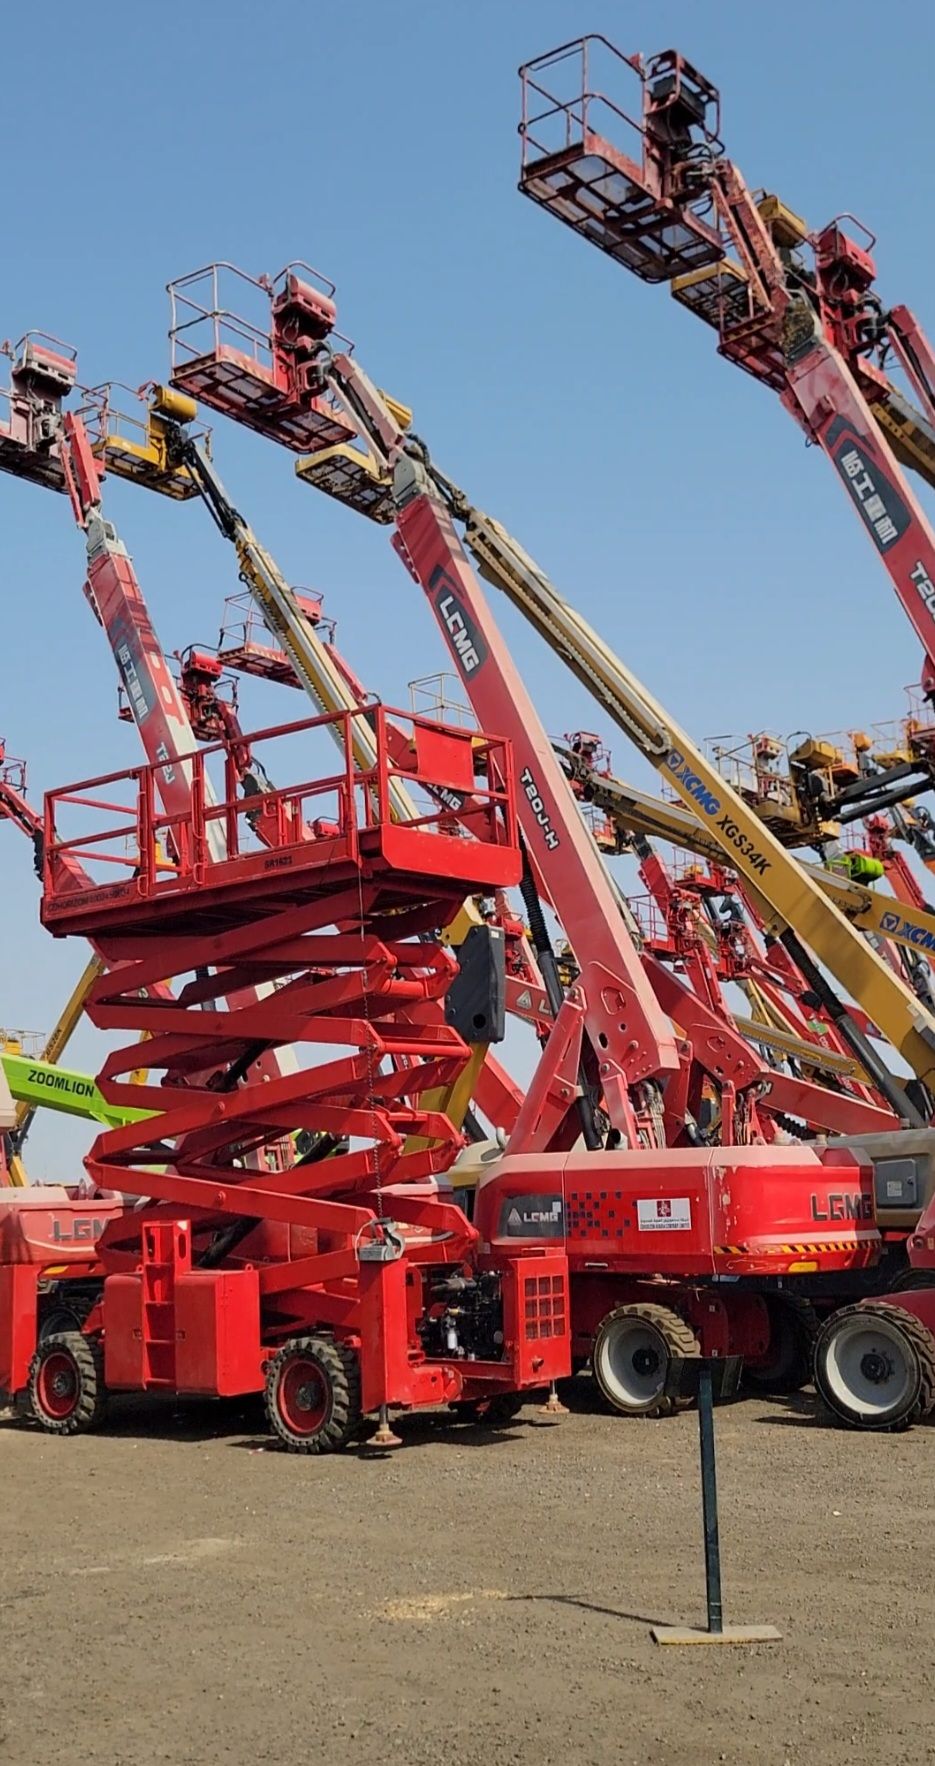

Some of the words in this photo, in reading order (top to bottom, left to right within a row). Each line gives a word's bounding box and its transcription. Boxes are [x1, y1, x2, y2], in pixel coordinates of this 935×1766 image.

[520, 767, 559, 851] T20J-H
[676, 765, 720, 815] XCMG
[716, 814, 772, 876] XGS34K
[28, 1069, 94, 1097] ZOOMLION
